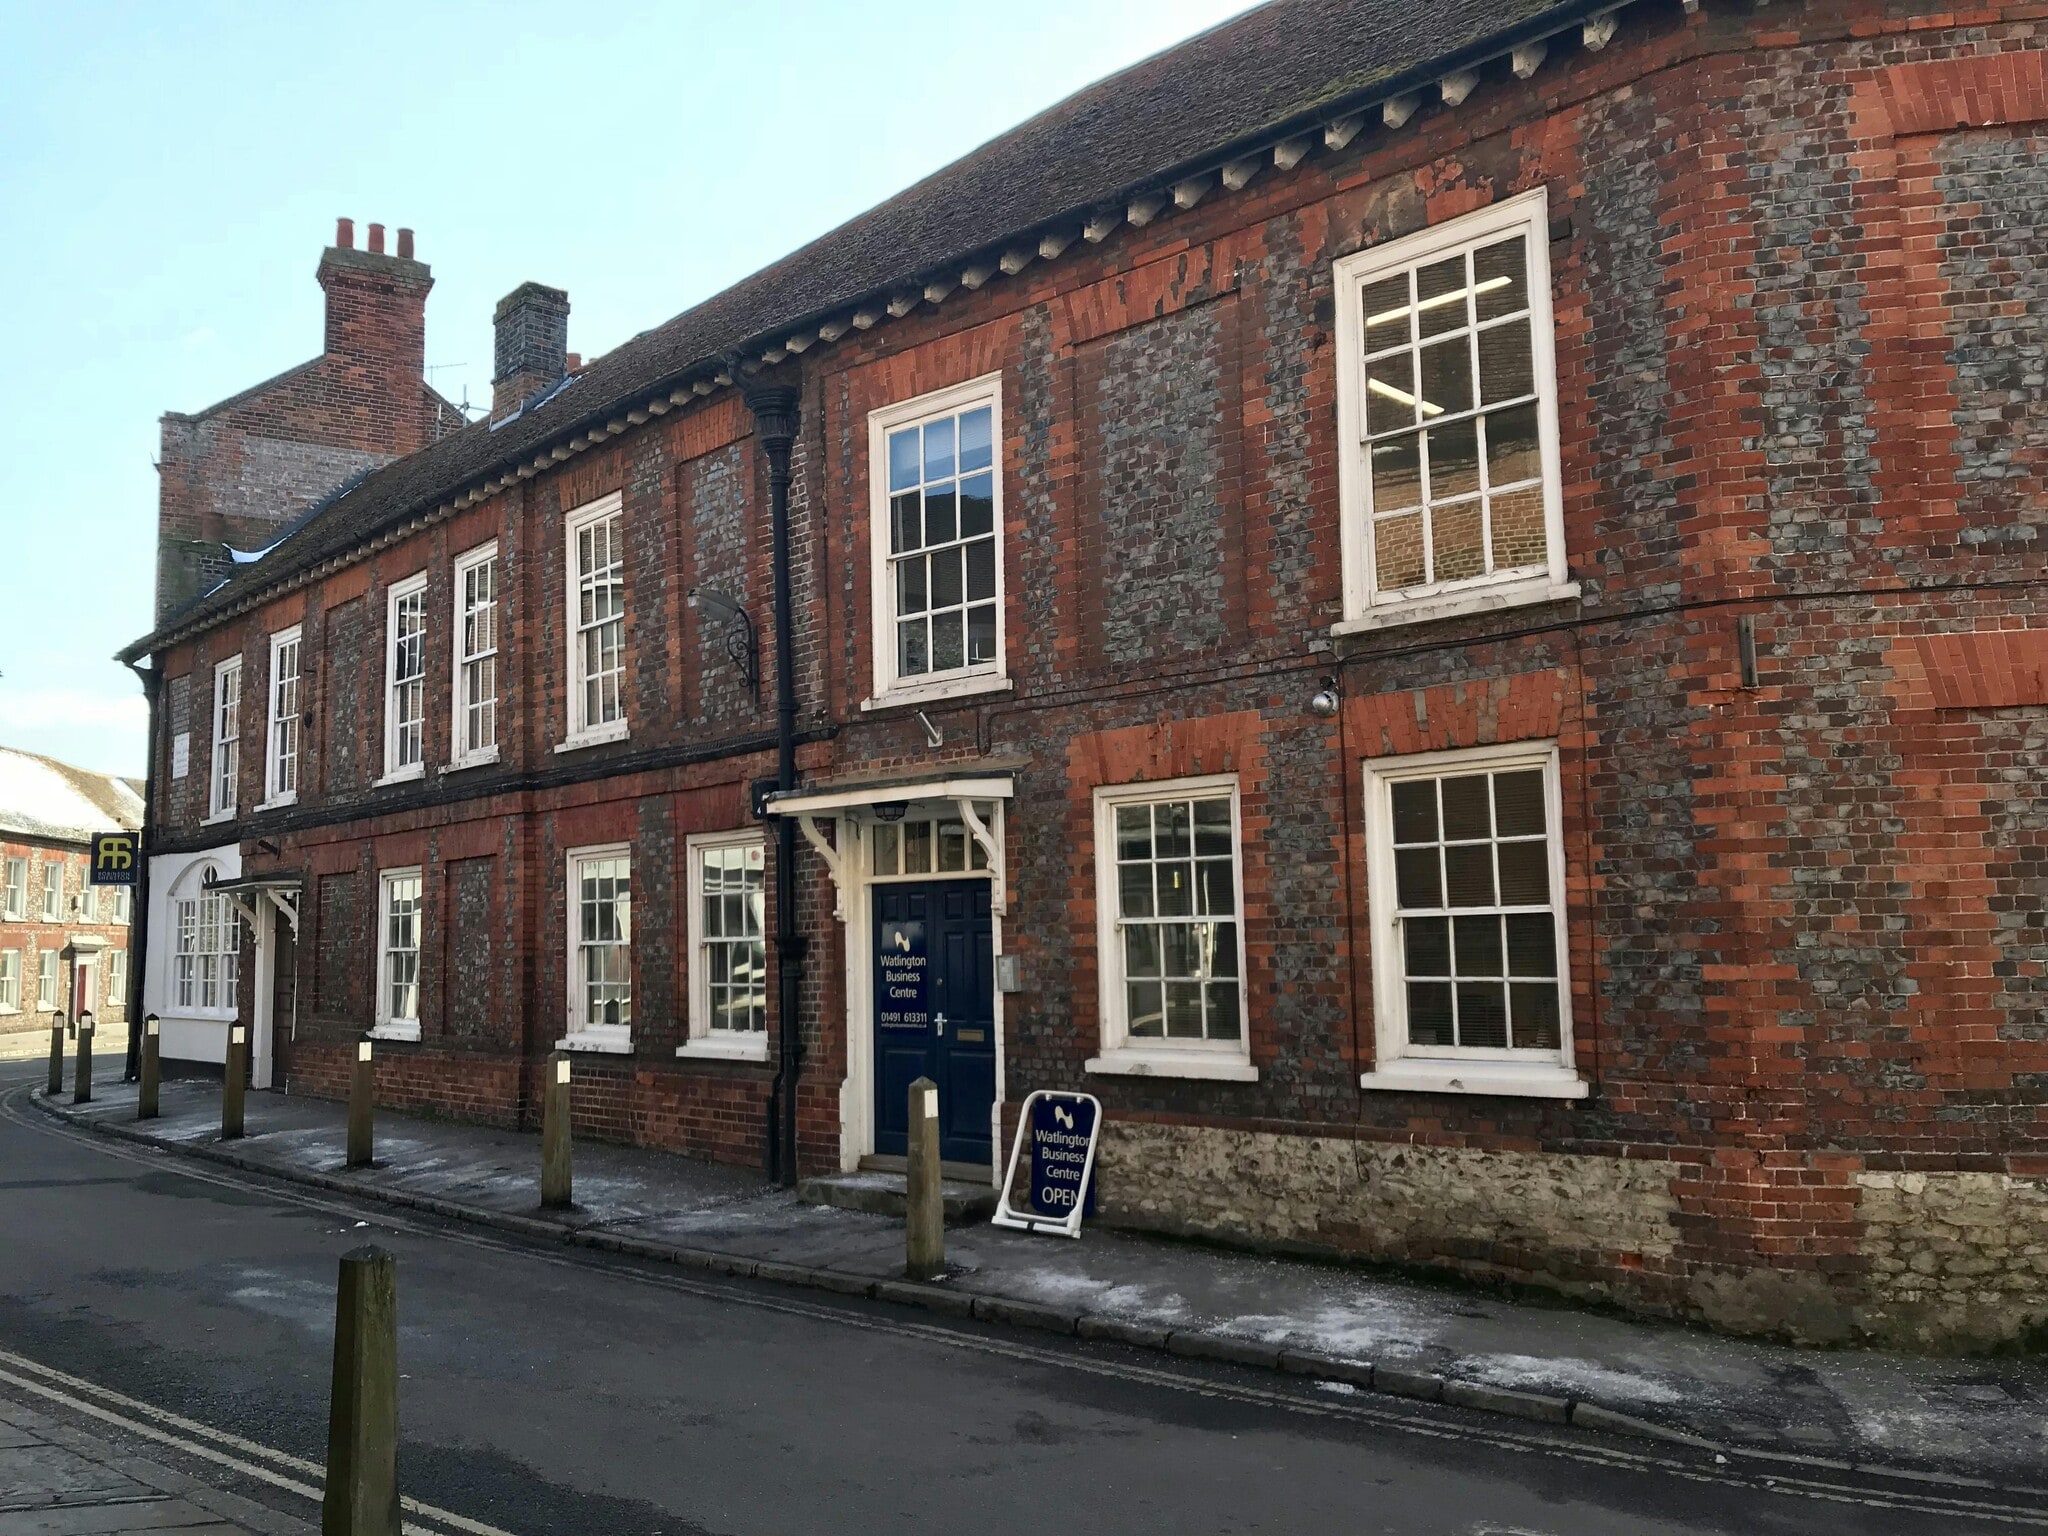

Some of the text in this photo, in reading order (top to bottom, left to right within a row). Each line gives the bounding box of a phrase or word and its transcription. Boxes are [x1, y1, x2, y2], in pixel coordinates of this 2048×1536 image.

[880, 955, 926, 969] Watlington
[886, 970, 920, 982] Business
[889, 986, 917, 998] Centre
[881, 1012, 927, 1022] 01491 613311
[1042, 1147, 1084, 1163] Business
[1046, 1165, 1080, 1181] Centre
